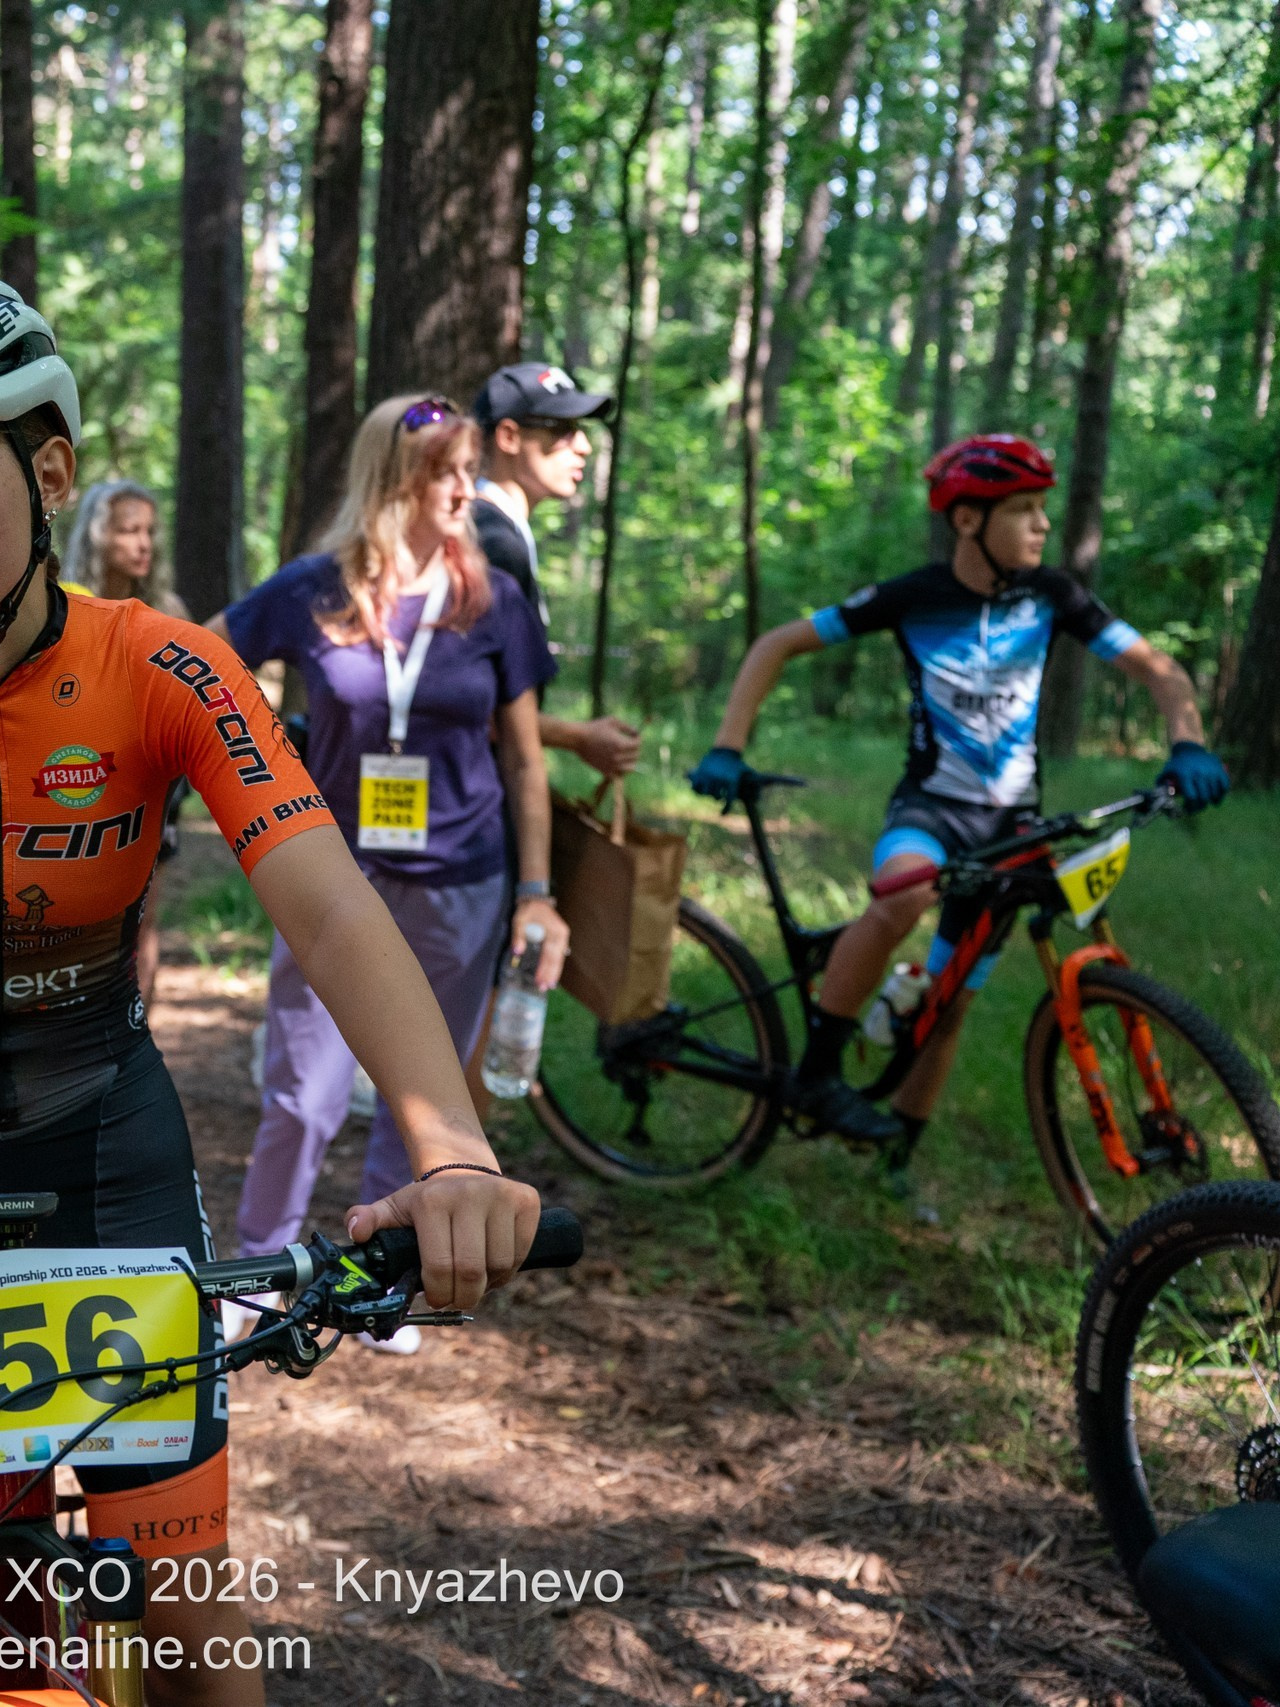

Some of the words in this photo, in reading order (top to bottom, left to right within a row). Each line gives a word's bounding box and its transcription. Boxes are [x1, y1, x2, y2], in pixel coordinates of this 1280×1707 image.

[147, 640, 275, 787] DOLTCINI
[42, 765, 108, 787] ИЗИДА
[372, 780, 417, 795] TECH
[372, 796, 416, 810] ZONE
[372, 812, 414, 826] PASS
[1086, 856, 1122, 901] 65
[3, 937, 34, 953] Spa
[49, 1267, 73, 1279] XCO
[75, 1265, 108, 1277] 2026
[117, 1263, 179, 1277] Knyazhevo
[131, 1514, 205, 1541] HOT
